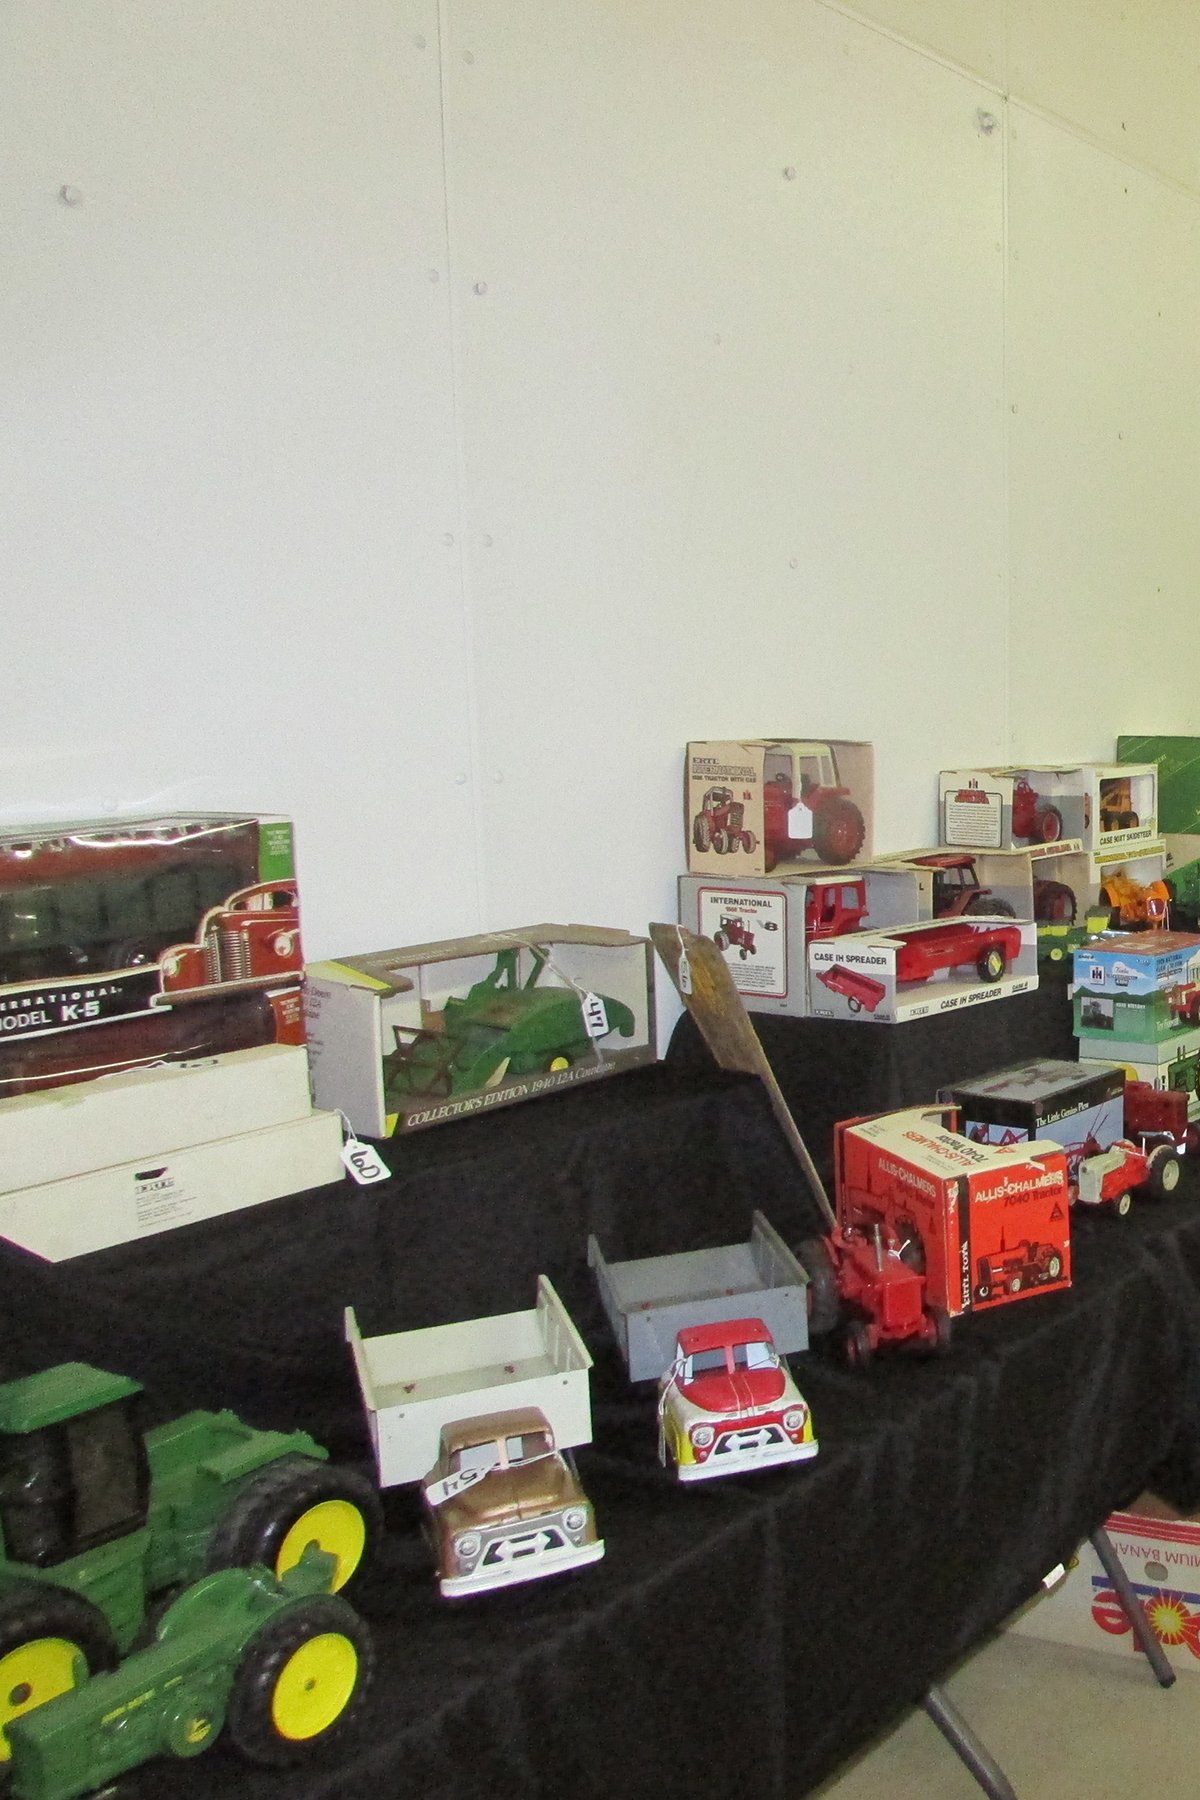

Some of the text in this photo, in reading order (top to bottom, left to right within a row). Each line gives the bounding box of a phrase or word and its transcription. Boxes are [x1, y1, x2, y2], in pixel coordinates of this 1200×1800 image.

[710, 896, 772, 908] INTERNATIONAL
[814, 952, 887, 966] CASE IH SPREADER
[940, 987, 1002, 1010] CASE IH SPREADER
[0, 1000, 100, 1031] ODEL K-5
[590, 1001, 604, 1028] 47
[407, 1096, 482, 1127] COLLECTOR'S
[484, 1084, 528, 1107] EDITION
[531, 1077, 556, 1094] 1940
[556, 1070, 575, 1086] 12A
[1036, 1101, 1089, 1128] The Little Genius Plow
[901, 1130, 976, 1167] ALLIS-CHALMERS
[878, 1158, 936, 1198] ALLIS-CHALMERS
[975, 1169, 1065, 1203] ALLIS-CHALMERS
[1003, 1186, 1063, 1208] 7040 Tractor
